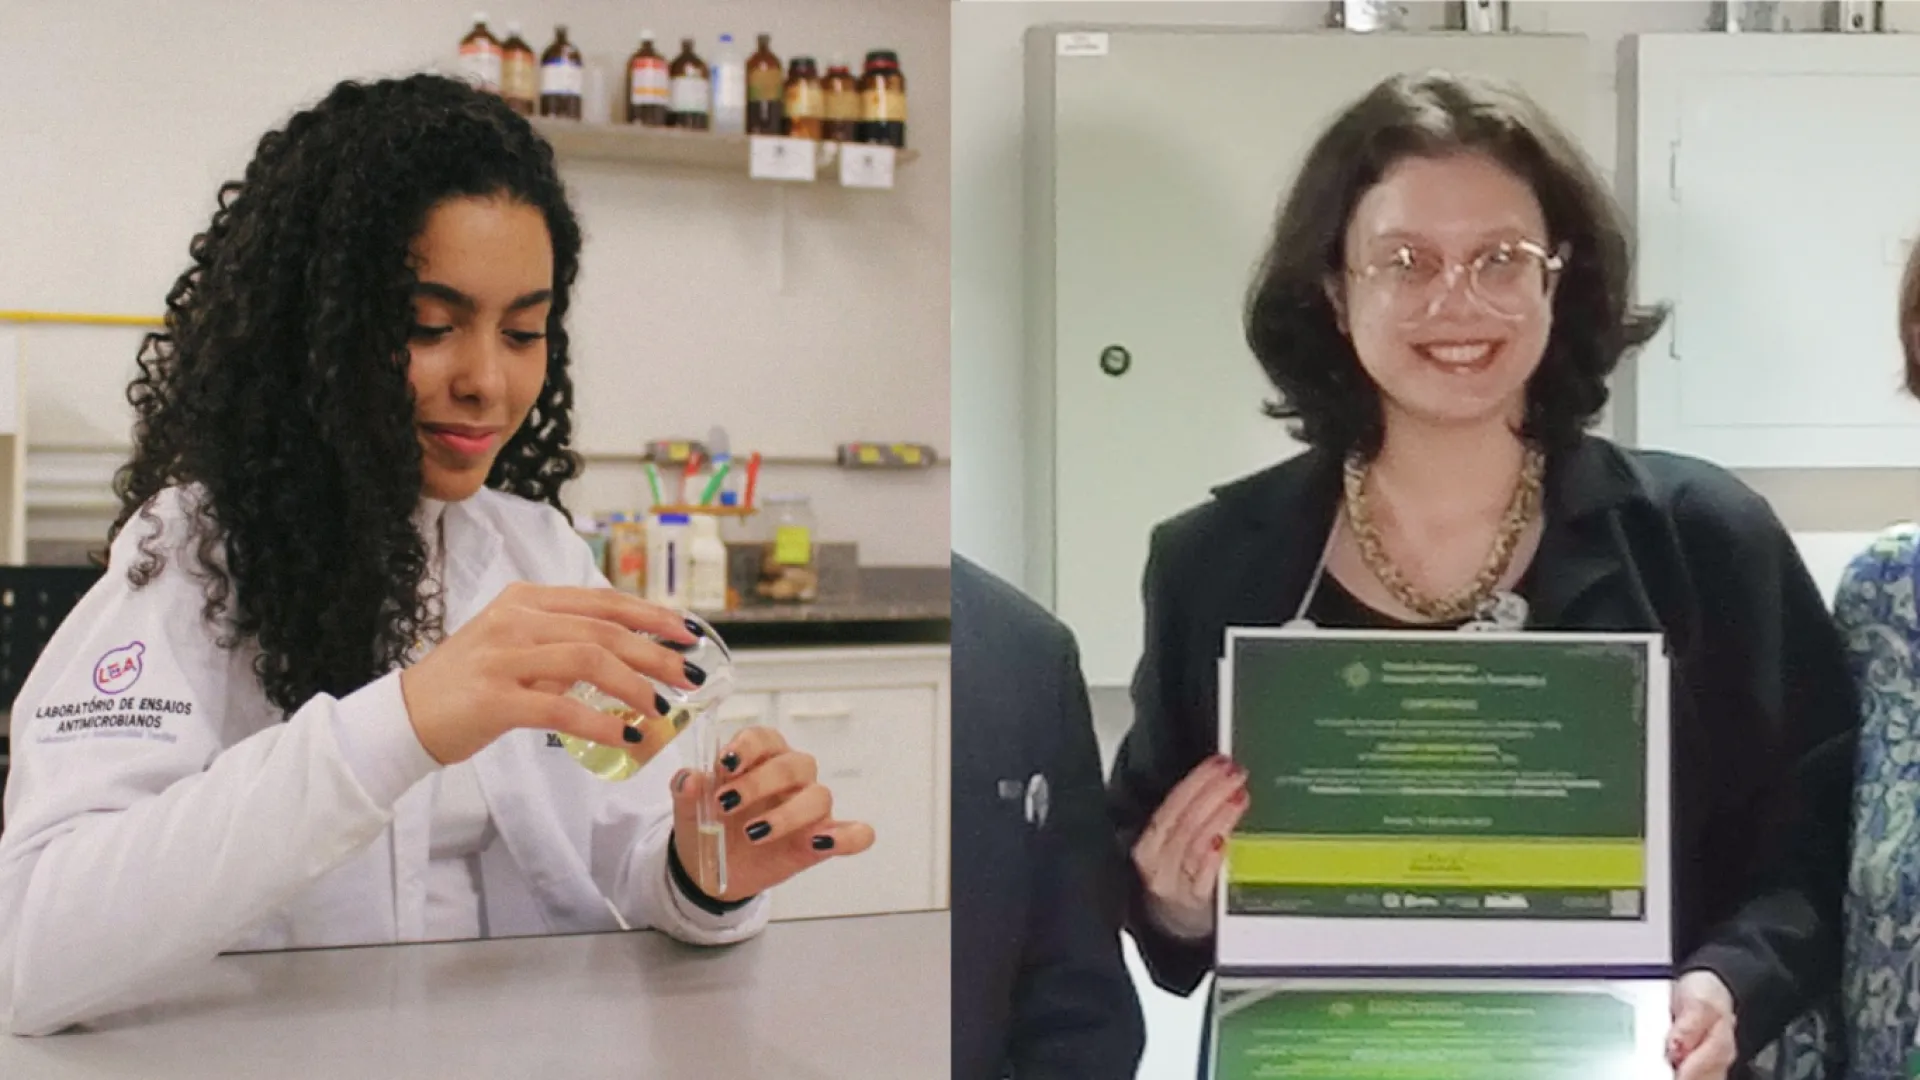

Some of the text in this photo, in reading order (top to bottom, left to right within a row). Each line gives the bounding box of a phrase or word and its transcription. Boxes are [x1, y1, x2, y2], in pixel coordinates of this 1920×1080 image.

[36, 696, 193, 719] LABORATÓRIO DE ENSAIOS
[57, 715, 163, 733] ANTIMICROBIANOS
